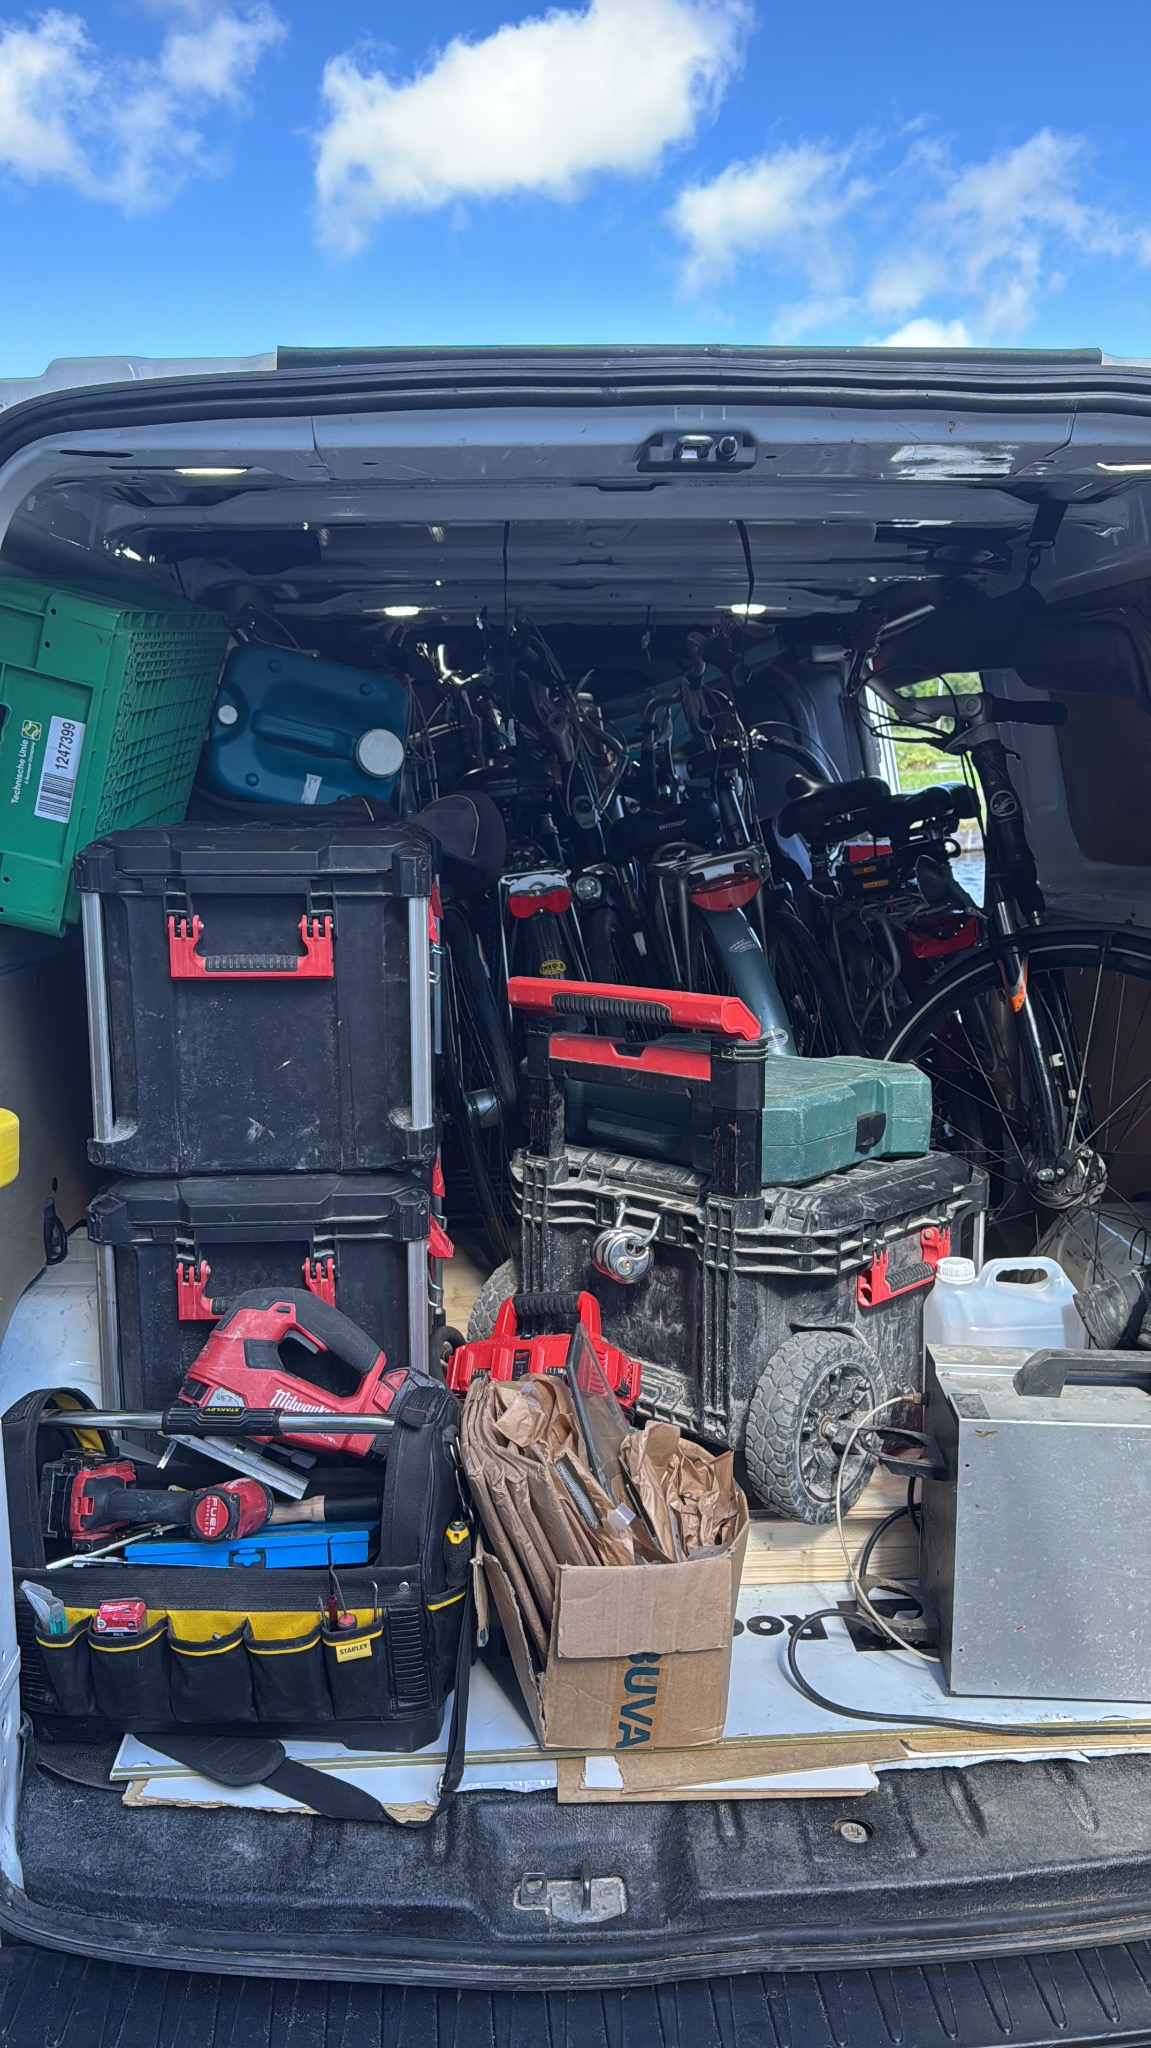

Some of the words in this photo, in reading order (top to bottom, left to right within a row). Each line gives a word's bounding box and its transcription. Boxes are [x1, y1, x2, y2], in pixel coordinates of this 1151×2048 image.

[18, 739, 29, 758] Unie
[54, 722, 76, 770] 1247399
[11, 758, 26, 803] Technische
[269, 1388, 337, 1413] Milwauk
[208, 1497, 218, 1536] FUEL
[340, 1643, 367, 1655] STANLEY
